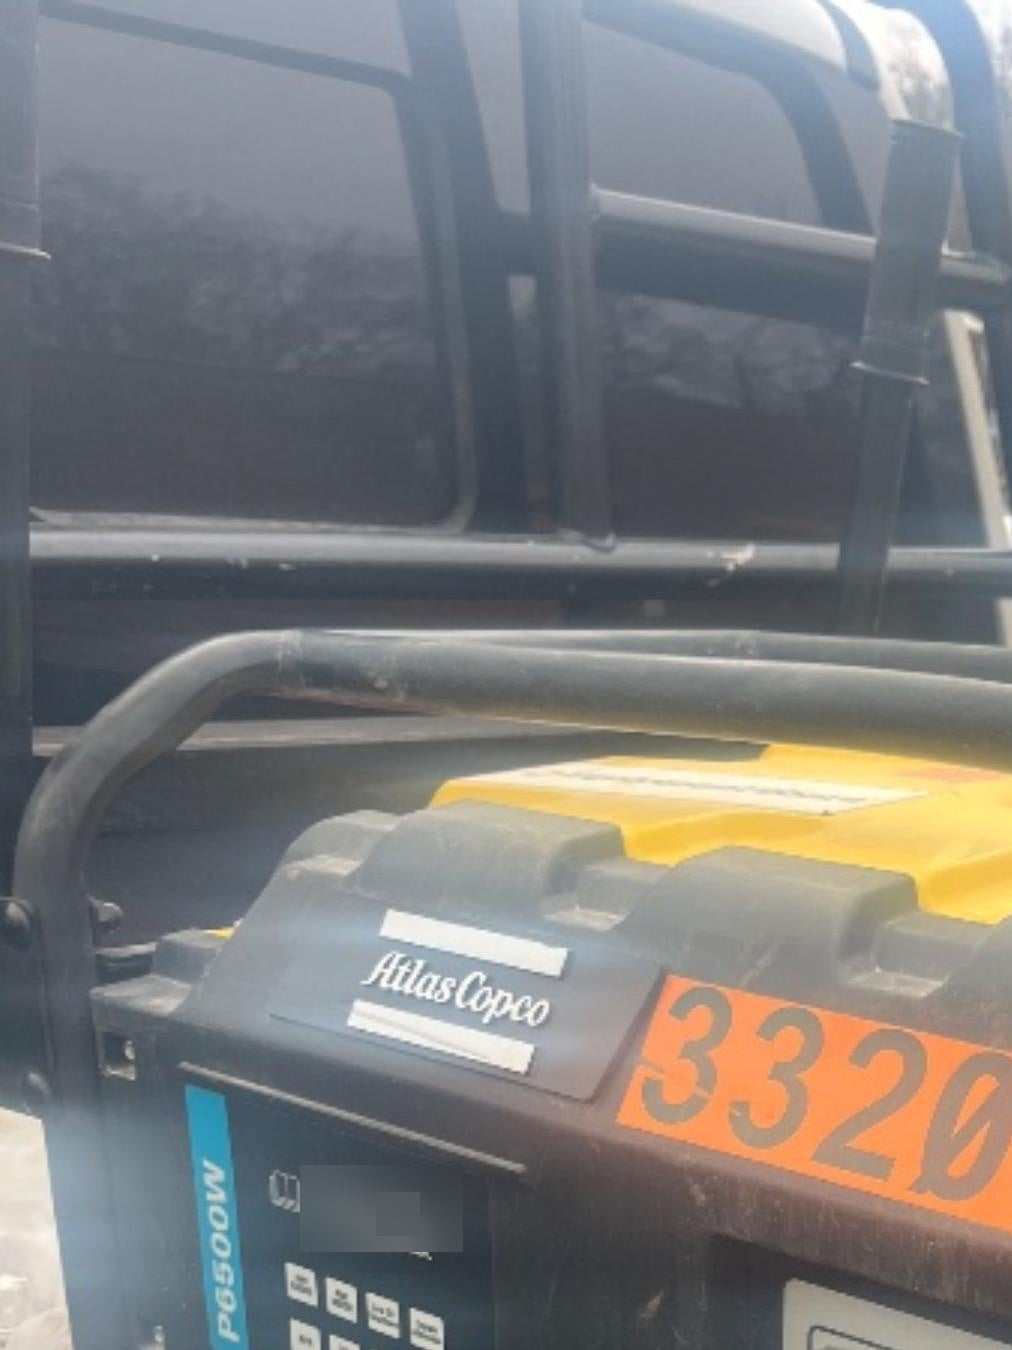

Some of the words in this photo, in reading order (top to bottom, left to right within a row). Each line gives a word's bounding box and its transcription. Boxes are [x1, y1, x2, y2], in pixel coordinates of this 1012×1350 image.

[360, 951, 456, 1003] Atlas
[455, 971, 549, 1027] Copco
[203, 1157, 240, 1343] P6500W
